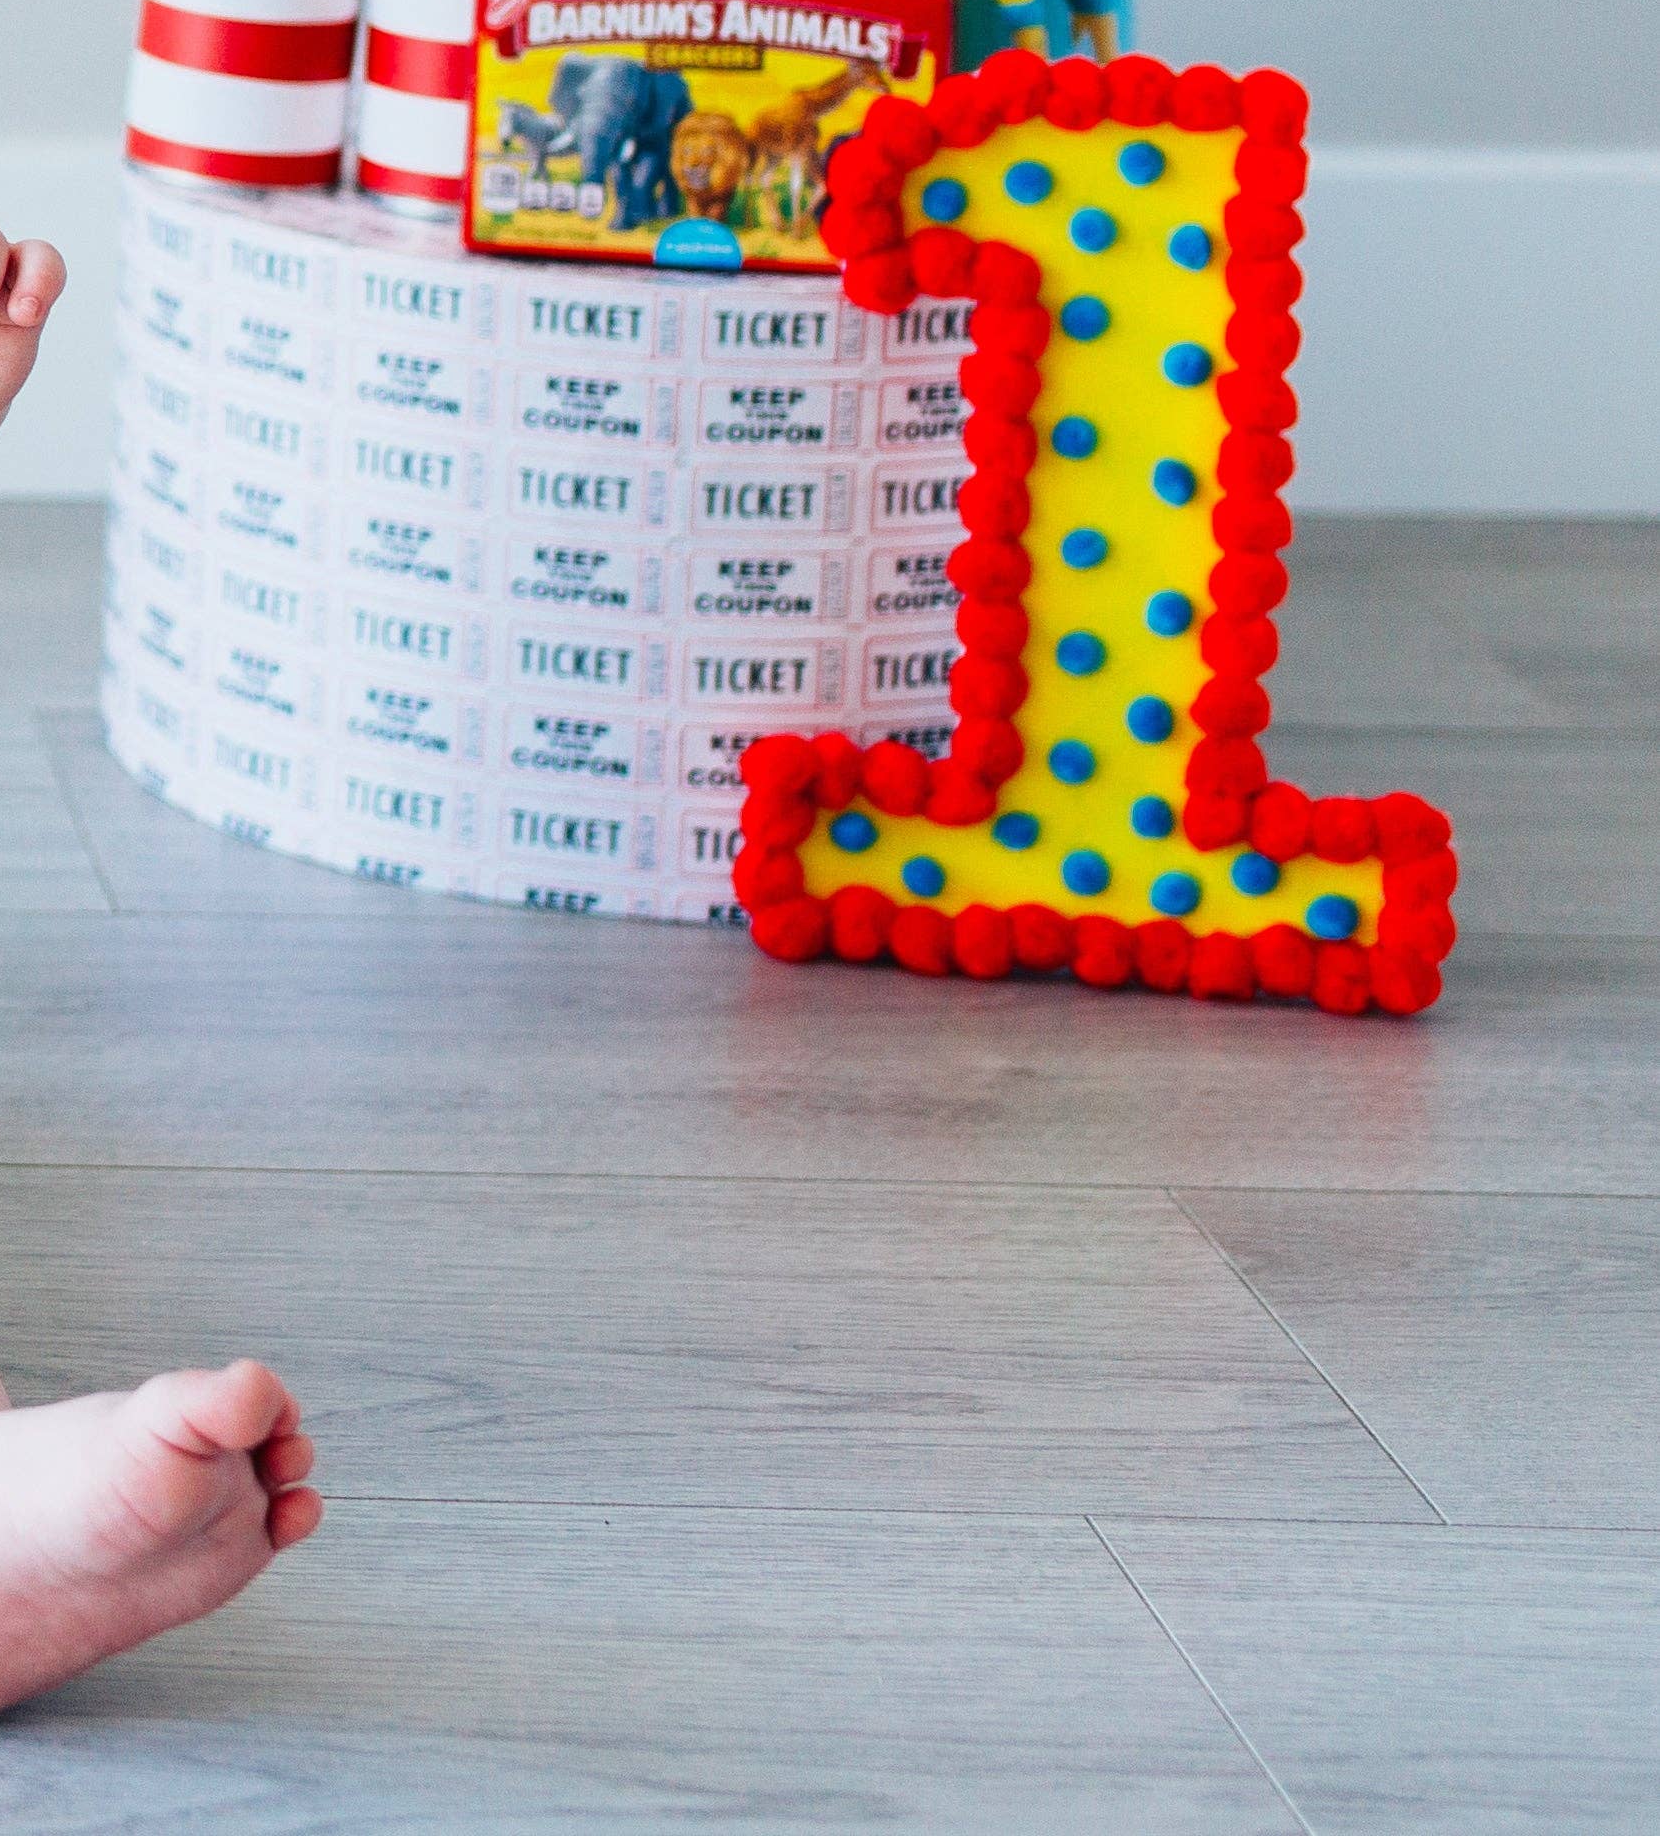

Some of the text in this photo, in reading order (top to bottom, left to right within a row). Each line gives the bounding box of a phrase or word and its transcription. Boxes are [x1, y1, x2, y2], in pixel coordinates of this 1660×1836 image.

[528, 0, 715, 44] BARNUM'S
[364, 273, 463, 323] TICKET
[529, 296, 645, 342] TICKET
[715, 310, 829, 348] TICKET
[895, 308, 972, 346] TICK
[378, 352, 442, 375] KEEP
[357, 381, 461, 416] COUPON
[546, 375, 622, 398] KEEP
[730, 388, 806, 406] KEEP
[908, 385, 957, 403] KEE
[522, 407, 641, 438] COUPON
[706, 422, 824, 443] COUPON
[885, 419, 965, 442] COUP
[355, 439, 453, 490] TICKET
[519, 466, 631, 513] TICKET
[703, 482, 817, 520] TICKET
[368, 518, 434, 543] KEEP
[534, 546, 610, 568] KEEP
[717, 560, 794, 580] KEEP
[896, 556, 945, 575] KEE
[512, 576, 630, 609] COUPON
[695, 592, 813, 615] COUPON
[874, 591, 962, 613] COUPO
[353, 608, 451, 661] TICKET
[518, 638, 632, 685] TICKET
[694, 658, 808, 694] TICKET
[875, 649, 955, 690] TICKE
[366, 687, 431, 712] KEEP
[534, 716, 610, 739] KEEP
[712, 734, 761, 750] KE
[512, 746, 630, 779] COUPON
[688, 768, 744, 786] COU
[347, 776, 444, 829] TICKET
[510, 807, 622, 856] TICKET
[694, 827, 741, 862] TIC
[708, 904, 749, 930] KE
